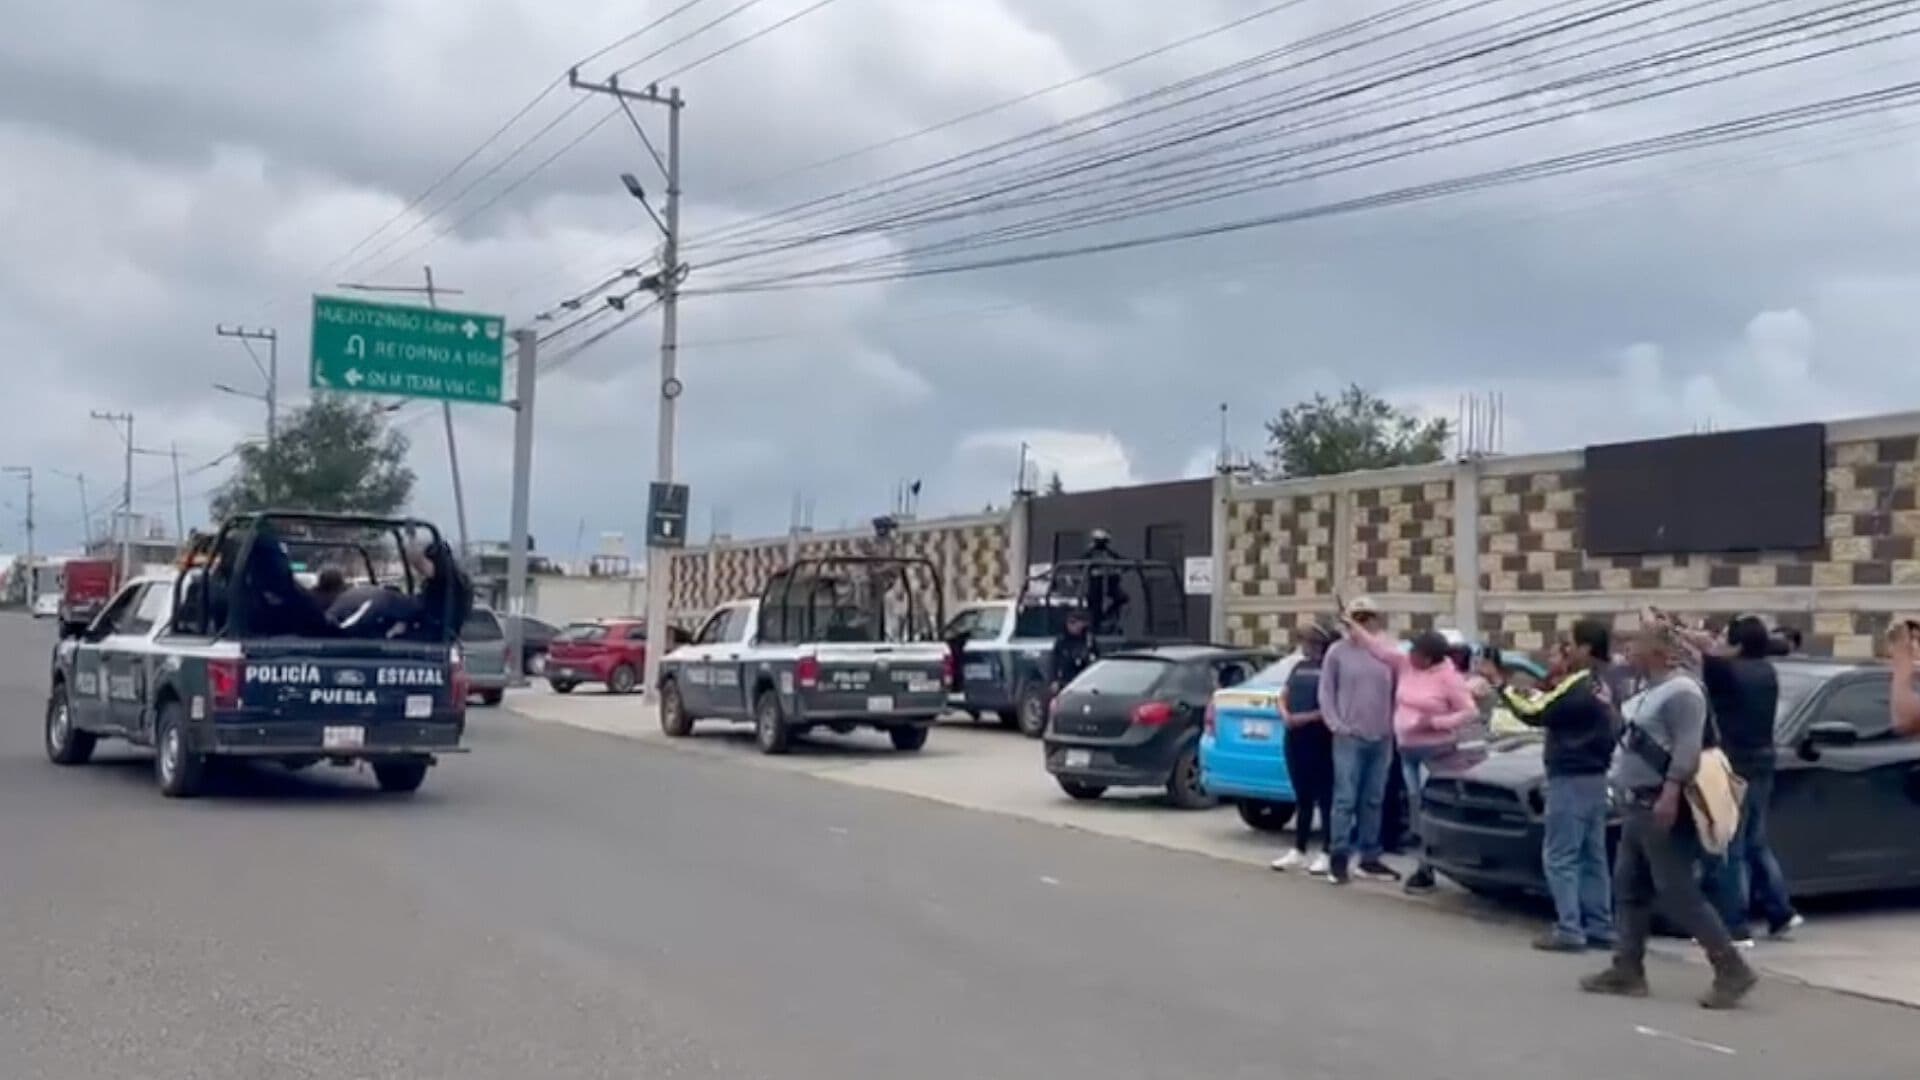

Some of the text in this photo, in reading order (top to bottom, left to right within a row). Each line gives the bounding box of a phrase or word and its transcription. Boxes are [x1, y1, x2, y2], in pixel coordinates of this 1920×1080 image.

[375, 341, 448, 362] RETORNO
[452, 350, 462, 362] A
[246, 663, 321, 683] POLICÍA
[377, 668, 444, 685] ESTATAL
[310, 688, 377, 704] PUEBLA
